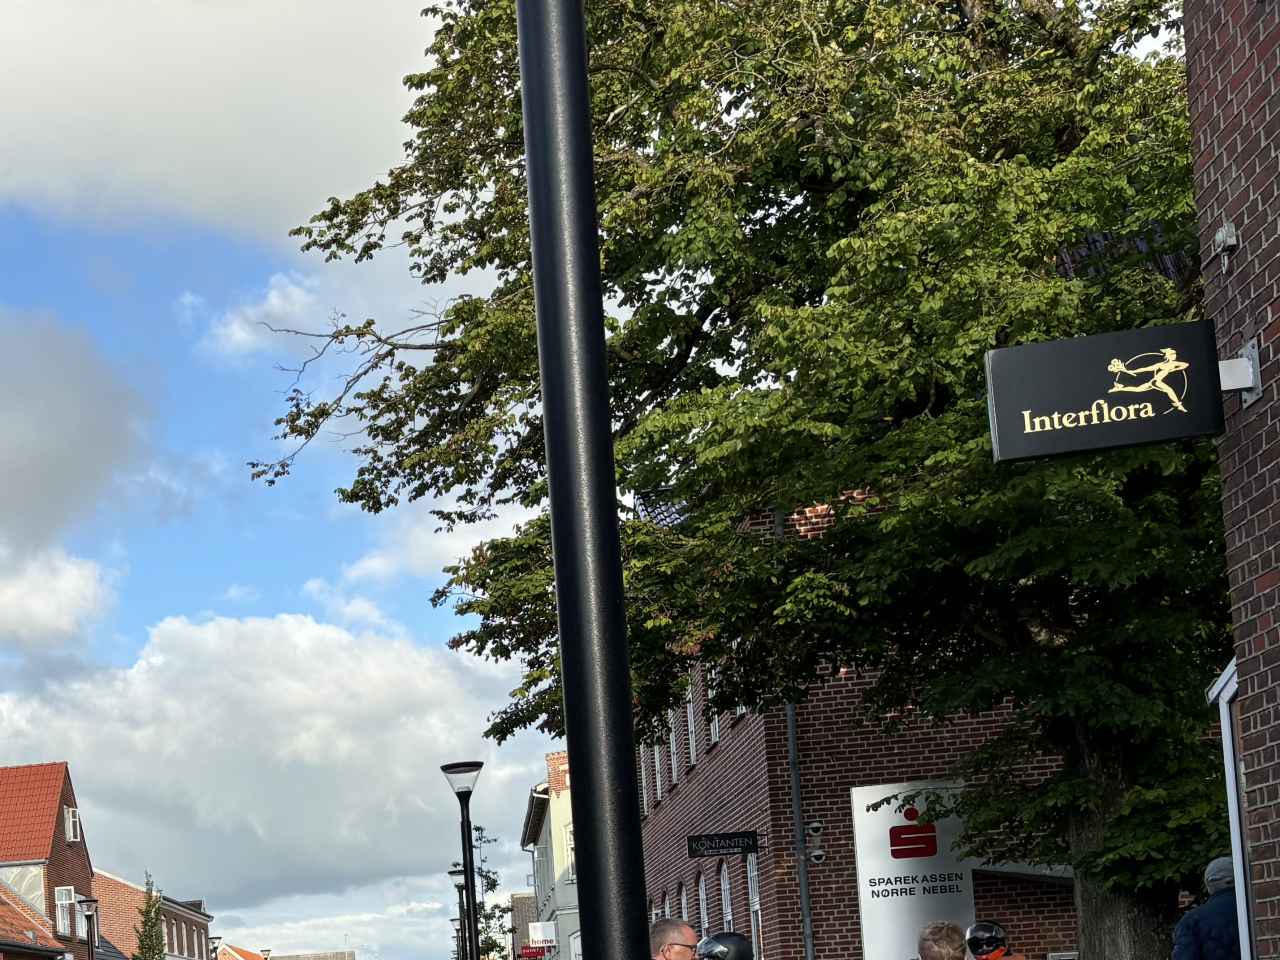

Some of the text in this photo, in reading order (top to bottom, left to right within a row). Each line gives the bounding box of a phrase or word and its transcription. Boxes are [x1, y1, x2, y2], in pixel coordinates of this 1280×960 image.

[1022, 399, 1156, 433] Interflora
[692, 837, 753, 850] KONTANTEN
[868, 872, 963, 887] SPAREKASSEN
[871, 884, 963, 899] NØRRE NEBEL
